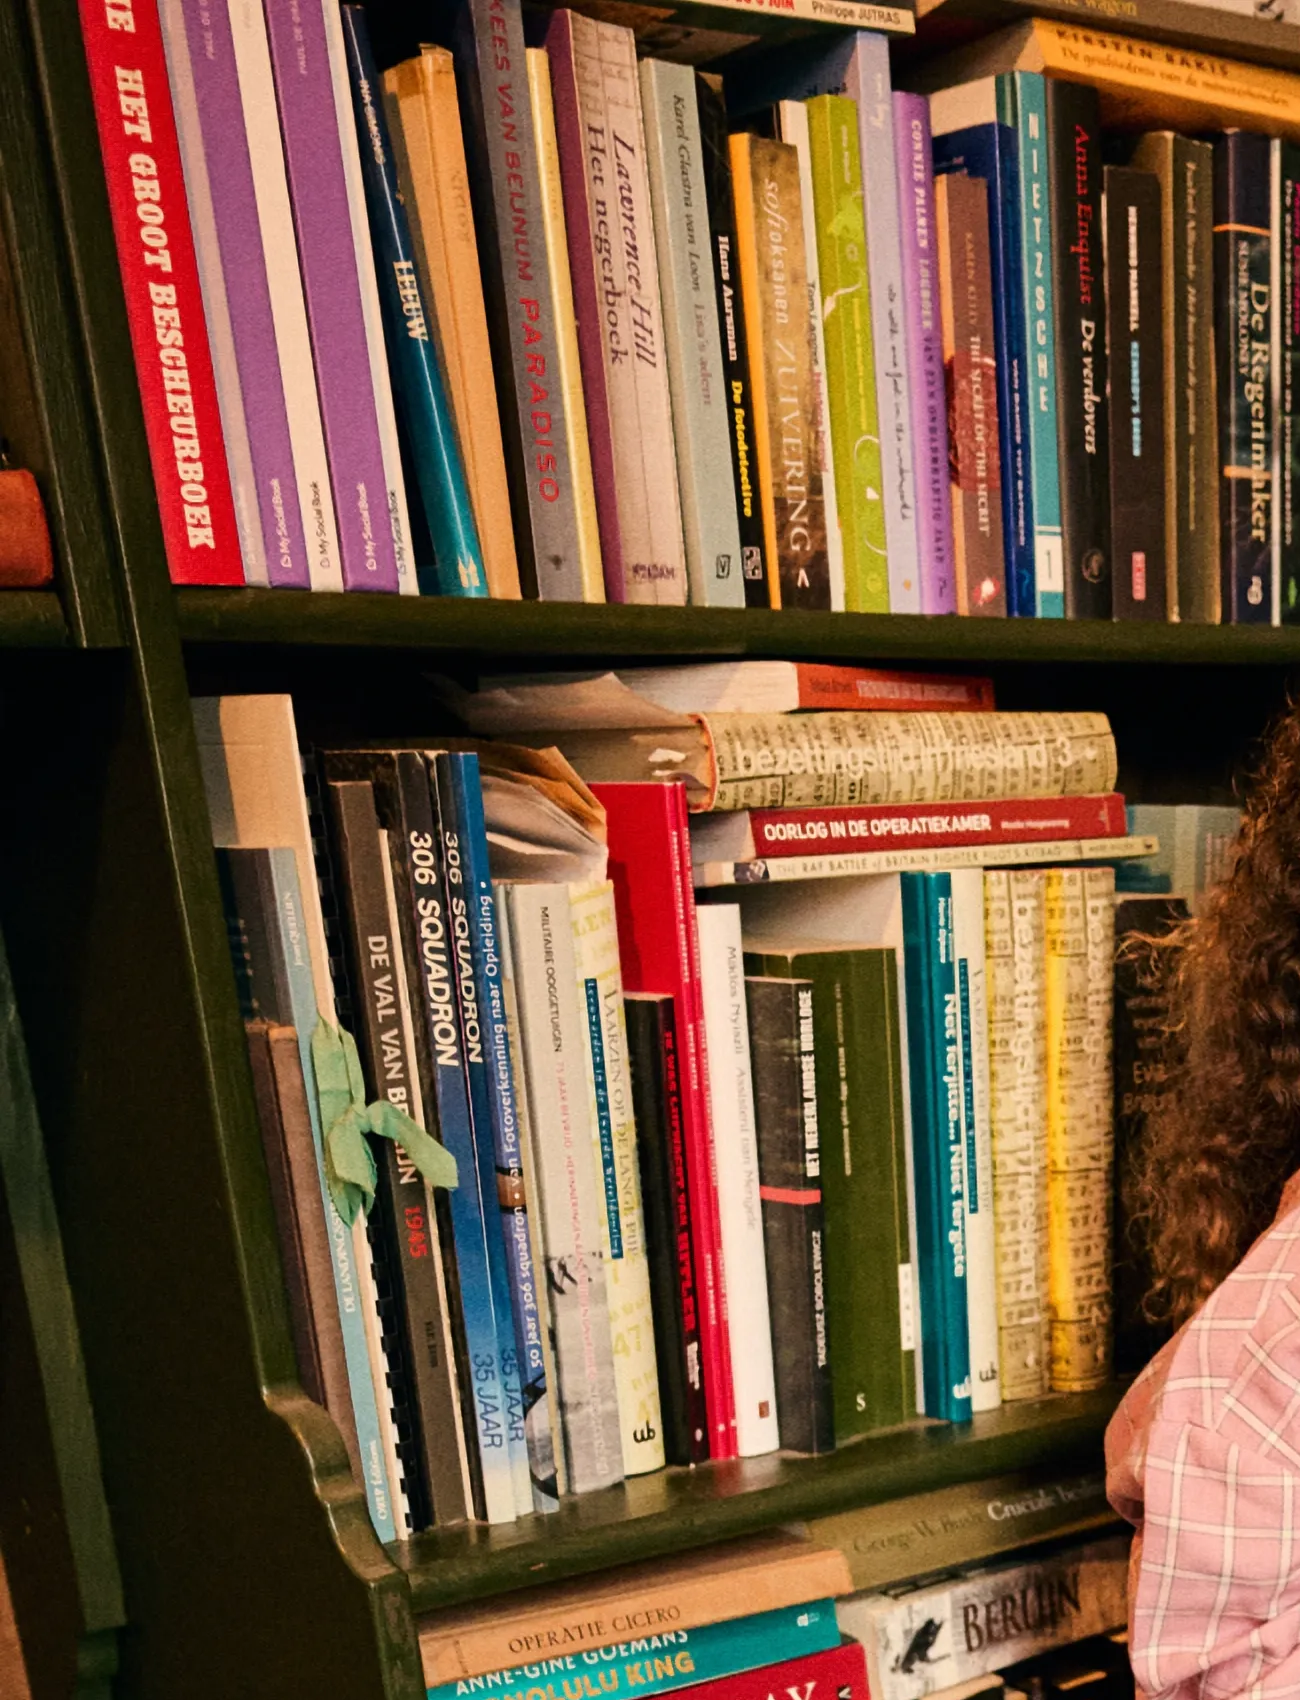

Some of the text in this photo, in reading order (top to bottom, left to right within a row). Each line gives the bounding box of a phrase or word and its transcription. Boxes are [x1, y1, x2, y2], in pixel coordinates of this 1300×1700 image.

[495, 82, 519, 143] VAN
[504, 153, 534, 281] BEIJNUM
[114, 63, 216, 551] HET GROOT BESCHEURBOEK
[392, 259, 428, 342] LEEUW
[582, 122, 634, 366] Het negerboek
[602, 129, 664, 368] Lawrence Hill
[1023, 112, 1054, 411] NIETZSCHE
[1070, 124, 1100, 453] Anna Enquist De verdovers
[516, 298, 560, 502] PARADISO
[715, 234, 755, 517] Hans Aarsman De fotodetective
[767, 337, 815, 553] ZUIVERING
[1244, 282, 1273, 541] De Regenmaker
[307, 480, 330, 555] My Social Book
[763, 819, 827, 841] OORLOG
[829, 819, 846, 838] IN
[848, 818, 868, 837] DE
[870, 813, 990, 837] OPERATIEKAMER
[364, 933, 406, 1080] DE VAL VAN
[407, 829, 459, 1068] 306 SQUADRON
[440, 831, 485, 1063] 306 SQUADRON
[401, 1204, 428, 1258] 1945
[476, 894, 544, 1367] 50 jaar 306 squadron van Fotoverkenning naar Opleiding
[470, 1351, 506, 1449] 35 JAAR
[508, 1606, 681, 1656] OPERATIE CICERO
[624, 1651, 695, 1688] KING
